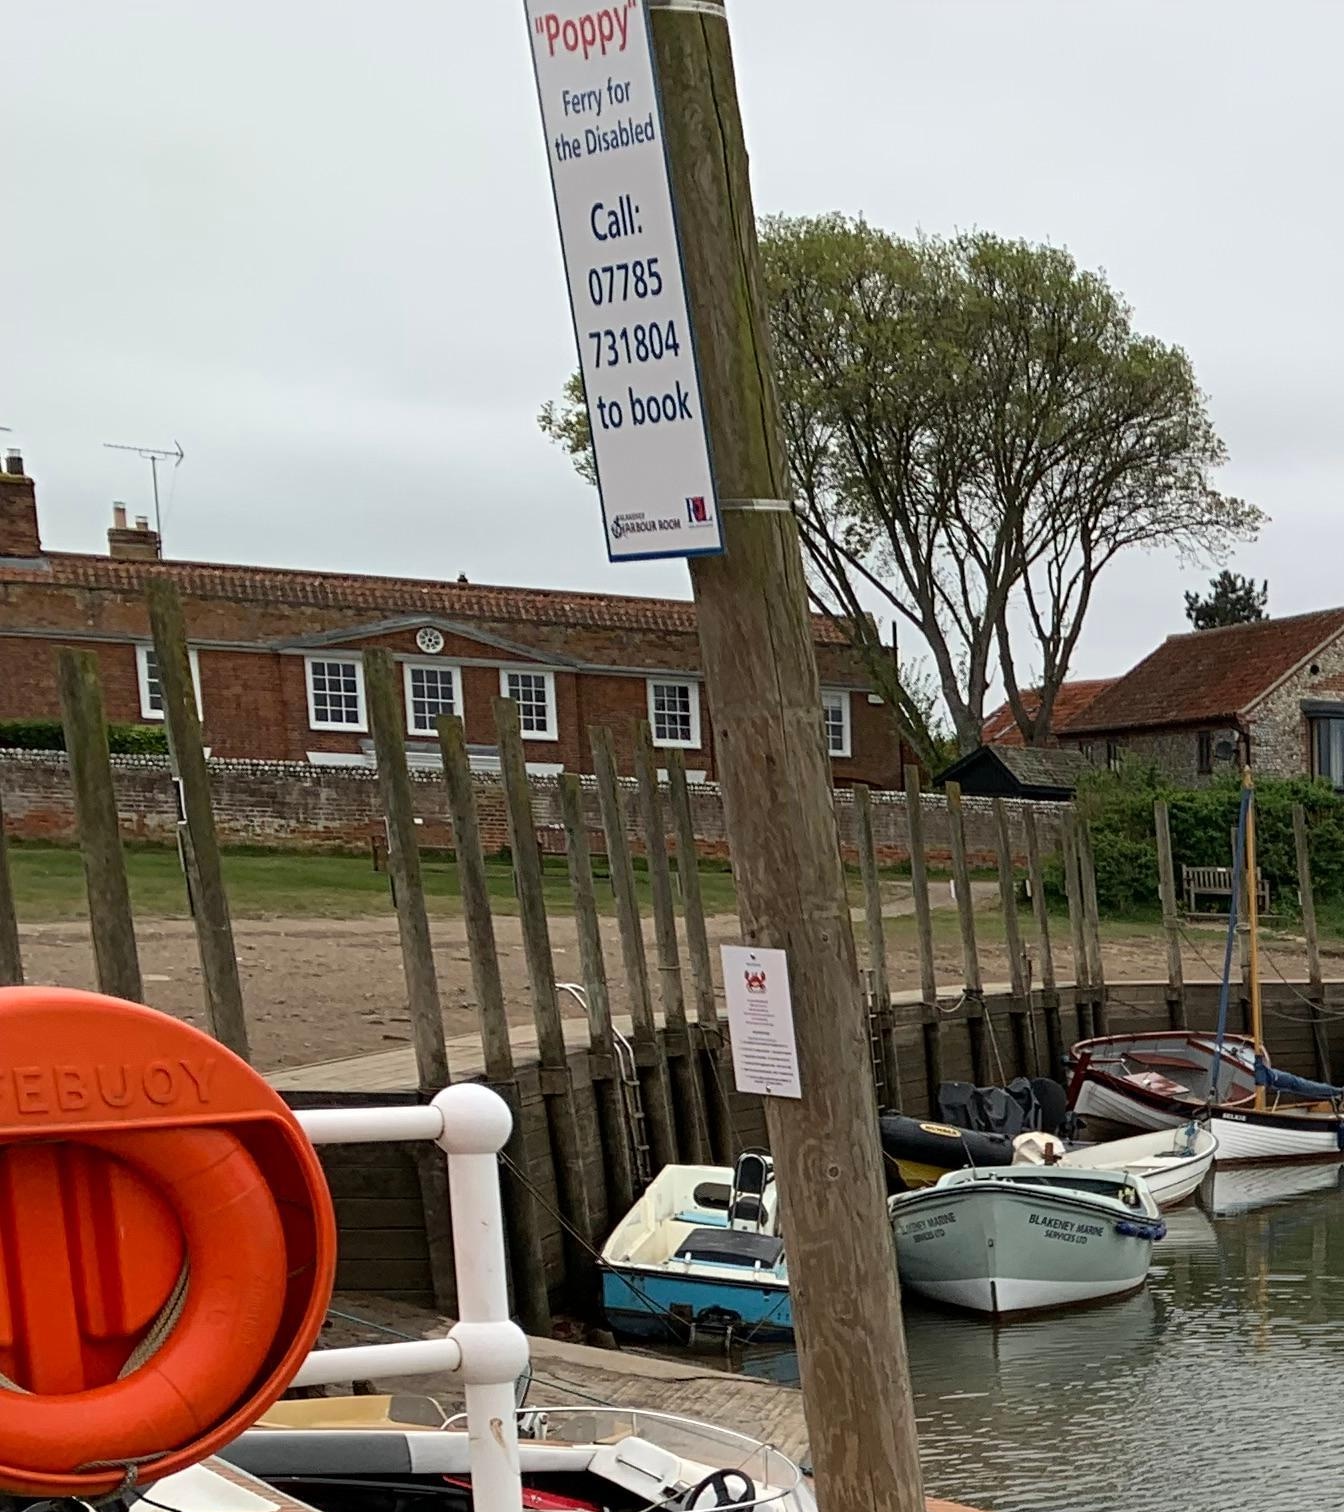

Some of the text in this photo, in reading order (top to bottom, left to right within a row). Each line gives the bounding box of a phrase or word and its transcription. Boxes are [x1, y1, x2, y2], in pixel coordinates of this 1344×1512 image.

[535, 0, 637, 60] "Poppy"
[562, 77, 631, 117] Ferry for
[554, 112, 656, 162] the Disabled
[590, 194, 643, 241] Call:
[588, 257, 663, 306] 07785
[588, 320, 680, 368] 731804
[597, 380, 692, 429] to book
[1028, 1213, 1075, 1231] BLAKENEY
[1044, 1229, 1076, 1242] SERVICES
